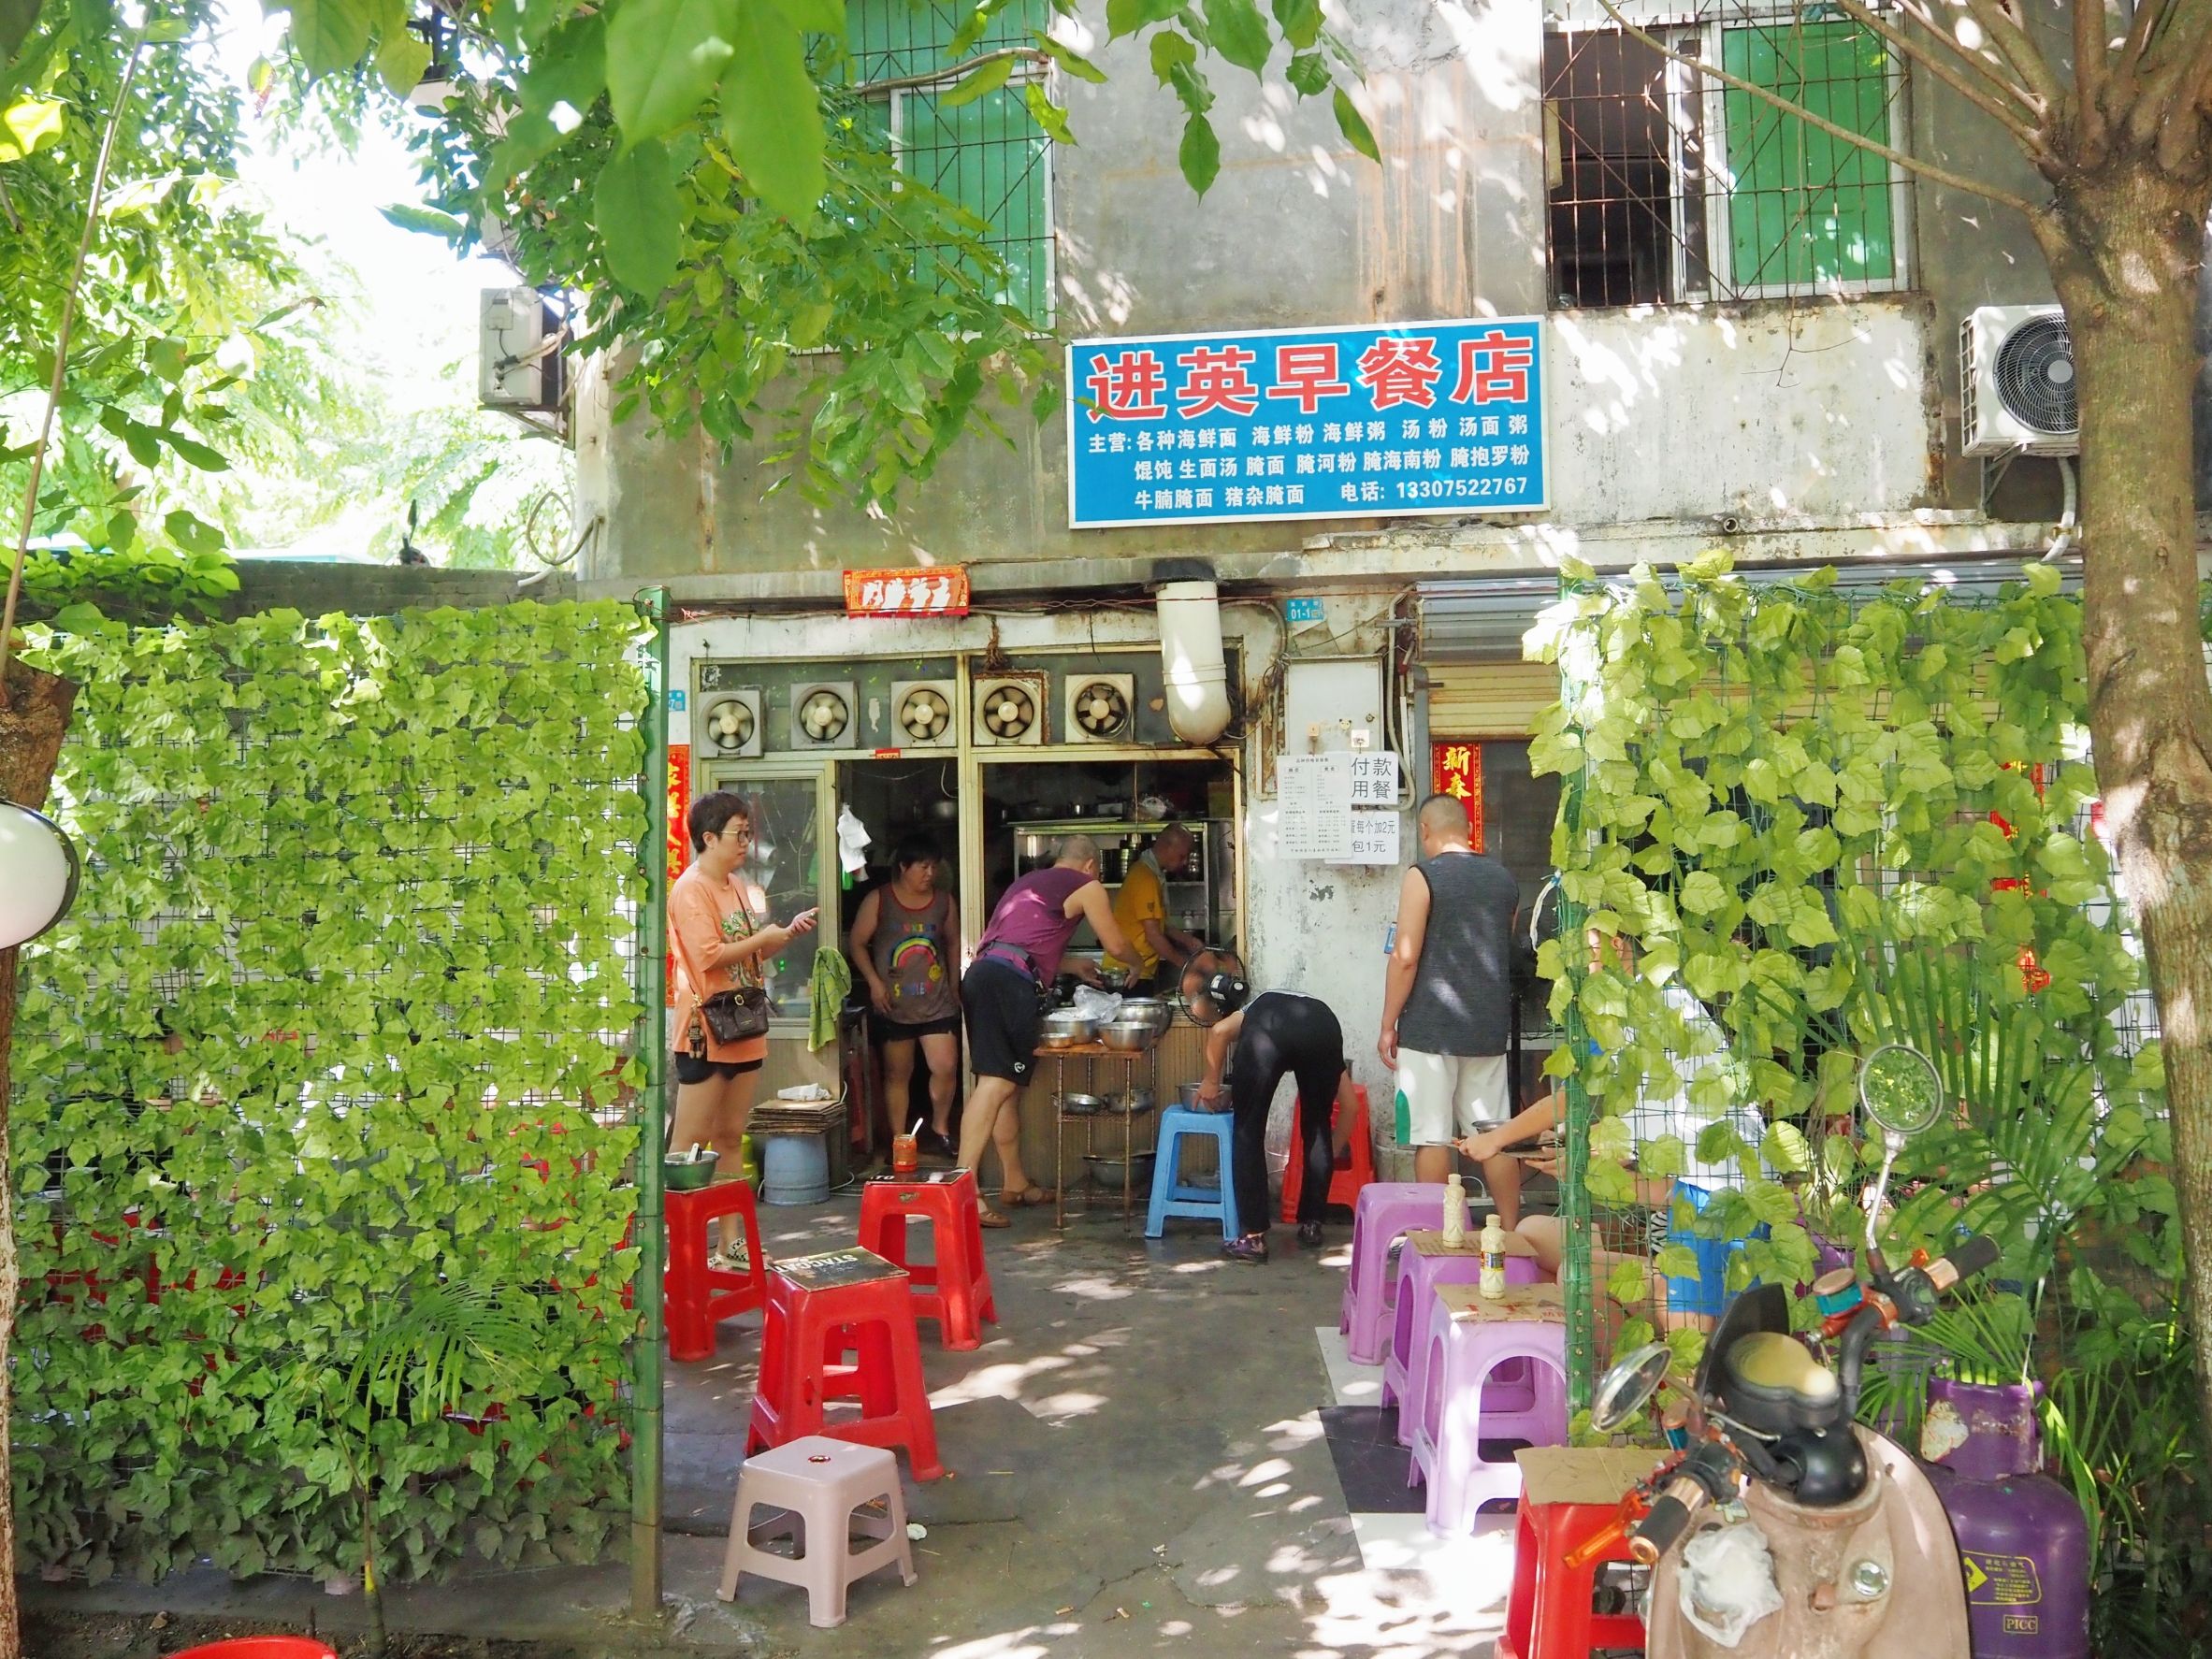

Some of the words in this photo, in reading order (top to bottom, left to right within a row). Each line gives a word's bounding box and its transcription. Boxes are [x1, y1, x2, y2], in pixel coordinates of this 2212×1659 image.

[1086, 329, 1533, 424] 进英早餐店
[1252, 424, 1314, 446] 海鲜粉
[1323, 421, 1386, 443] 海鲜粥
[1135, 459, 1173, 481] 馄饨
[1178, 457, 1237, 479] 生面汤
[1246, 454, 1285, 476] 腌面
[1295, 452, 1356, 474] 腌河粉
[1363, 448, 1442, 471] 腌海南粉
[1451, 444, 1530, 469] 腌抱罗粉
[1135, 488, 1213, 511] 牛腩腌面
[1225, 484, 1305, 508] 猪杂腌面
[1396, 477, 1527, 499] 13307522767
[1351, 757, 1393, 776] 付款
[1352, 780, 1392, 800] 用餐
[2006, 1618, 2036, 1630] PICC
